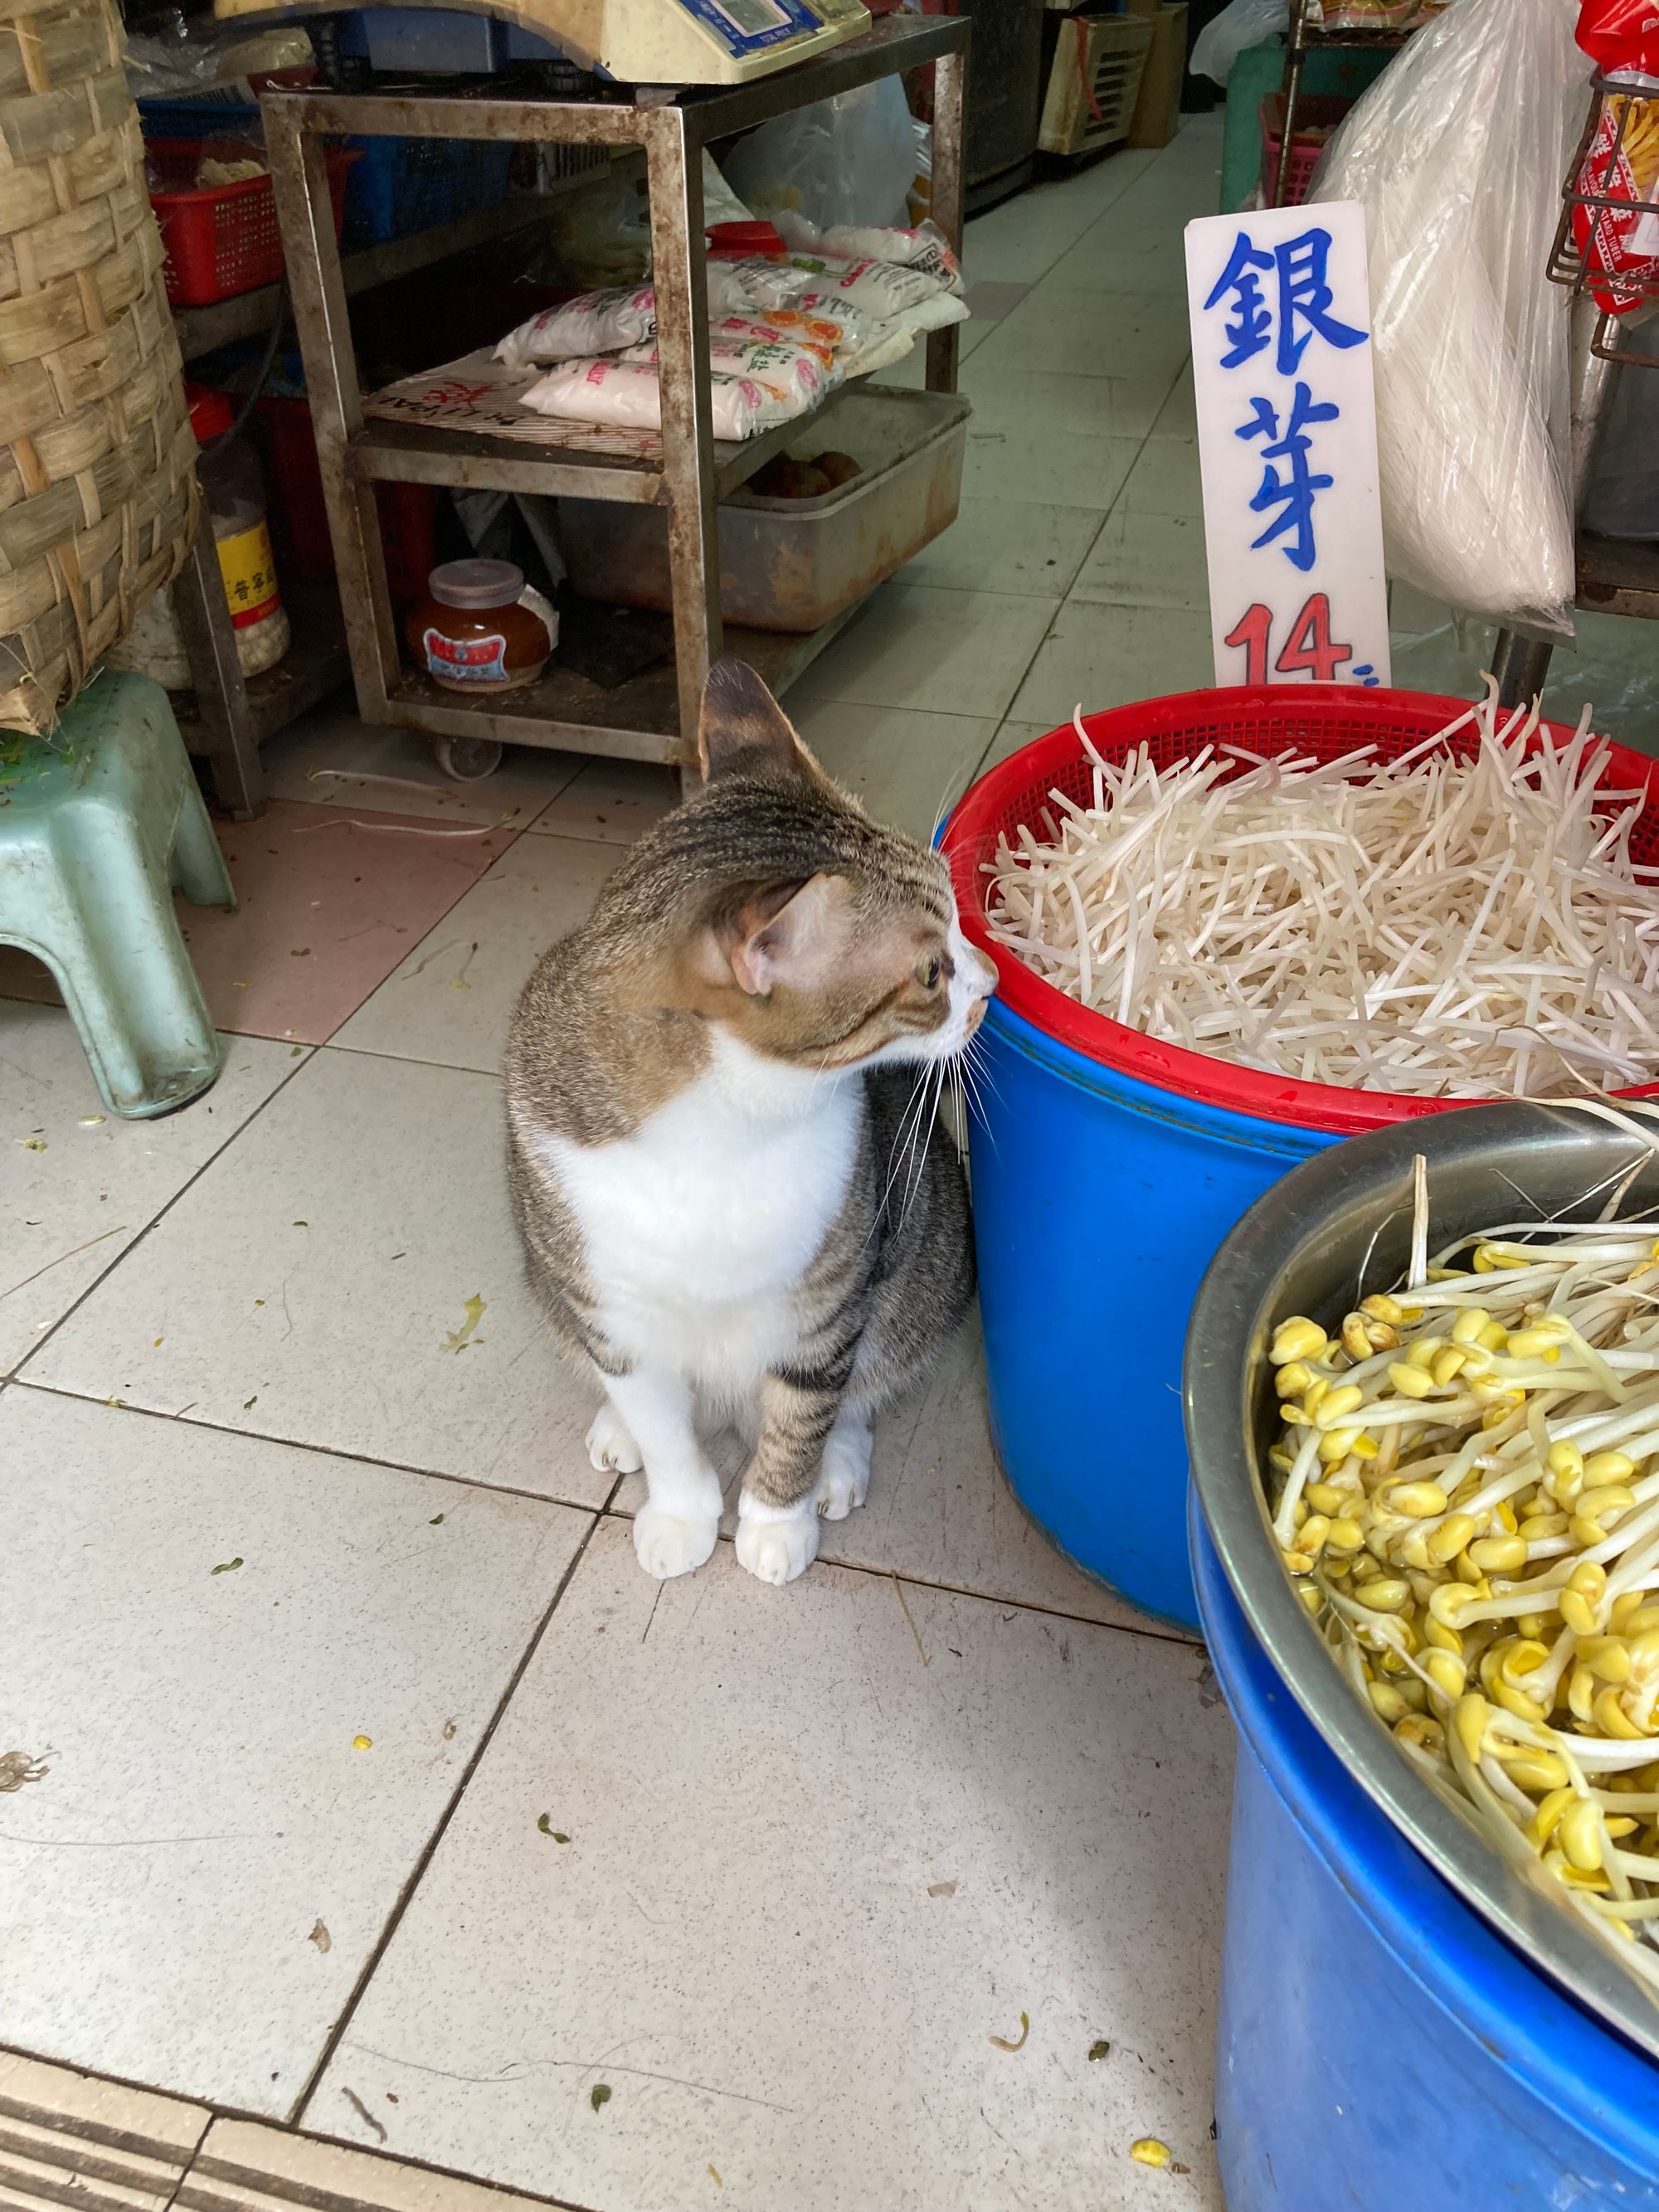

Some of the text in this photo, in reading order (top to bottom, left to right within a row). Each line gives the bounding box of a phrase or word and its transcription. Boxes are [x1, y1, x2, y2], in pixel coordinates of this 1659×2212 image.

[758, 27, 791, 44] TOTAL PRICE
[1608, 233, 1623, 263] TUBER
[1203, 226, 1370, 573] 銀芽
[1224, 592, 1354, 687] 14
